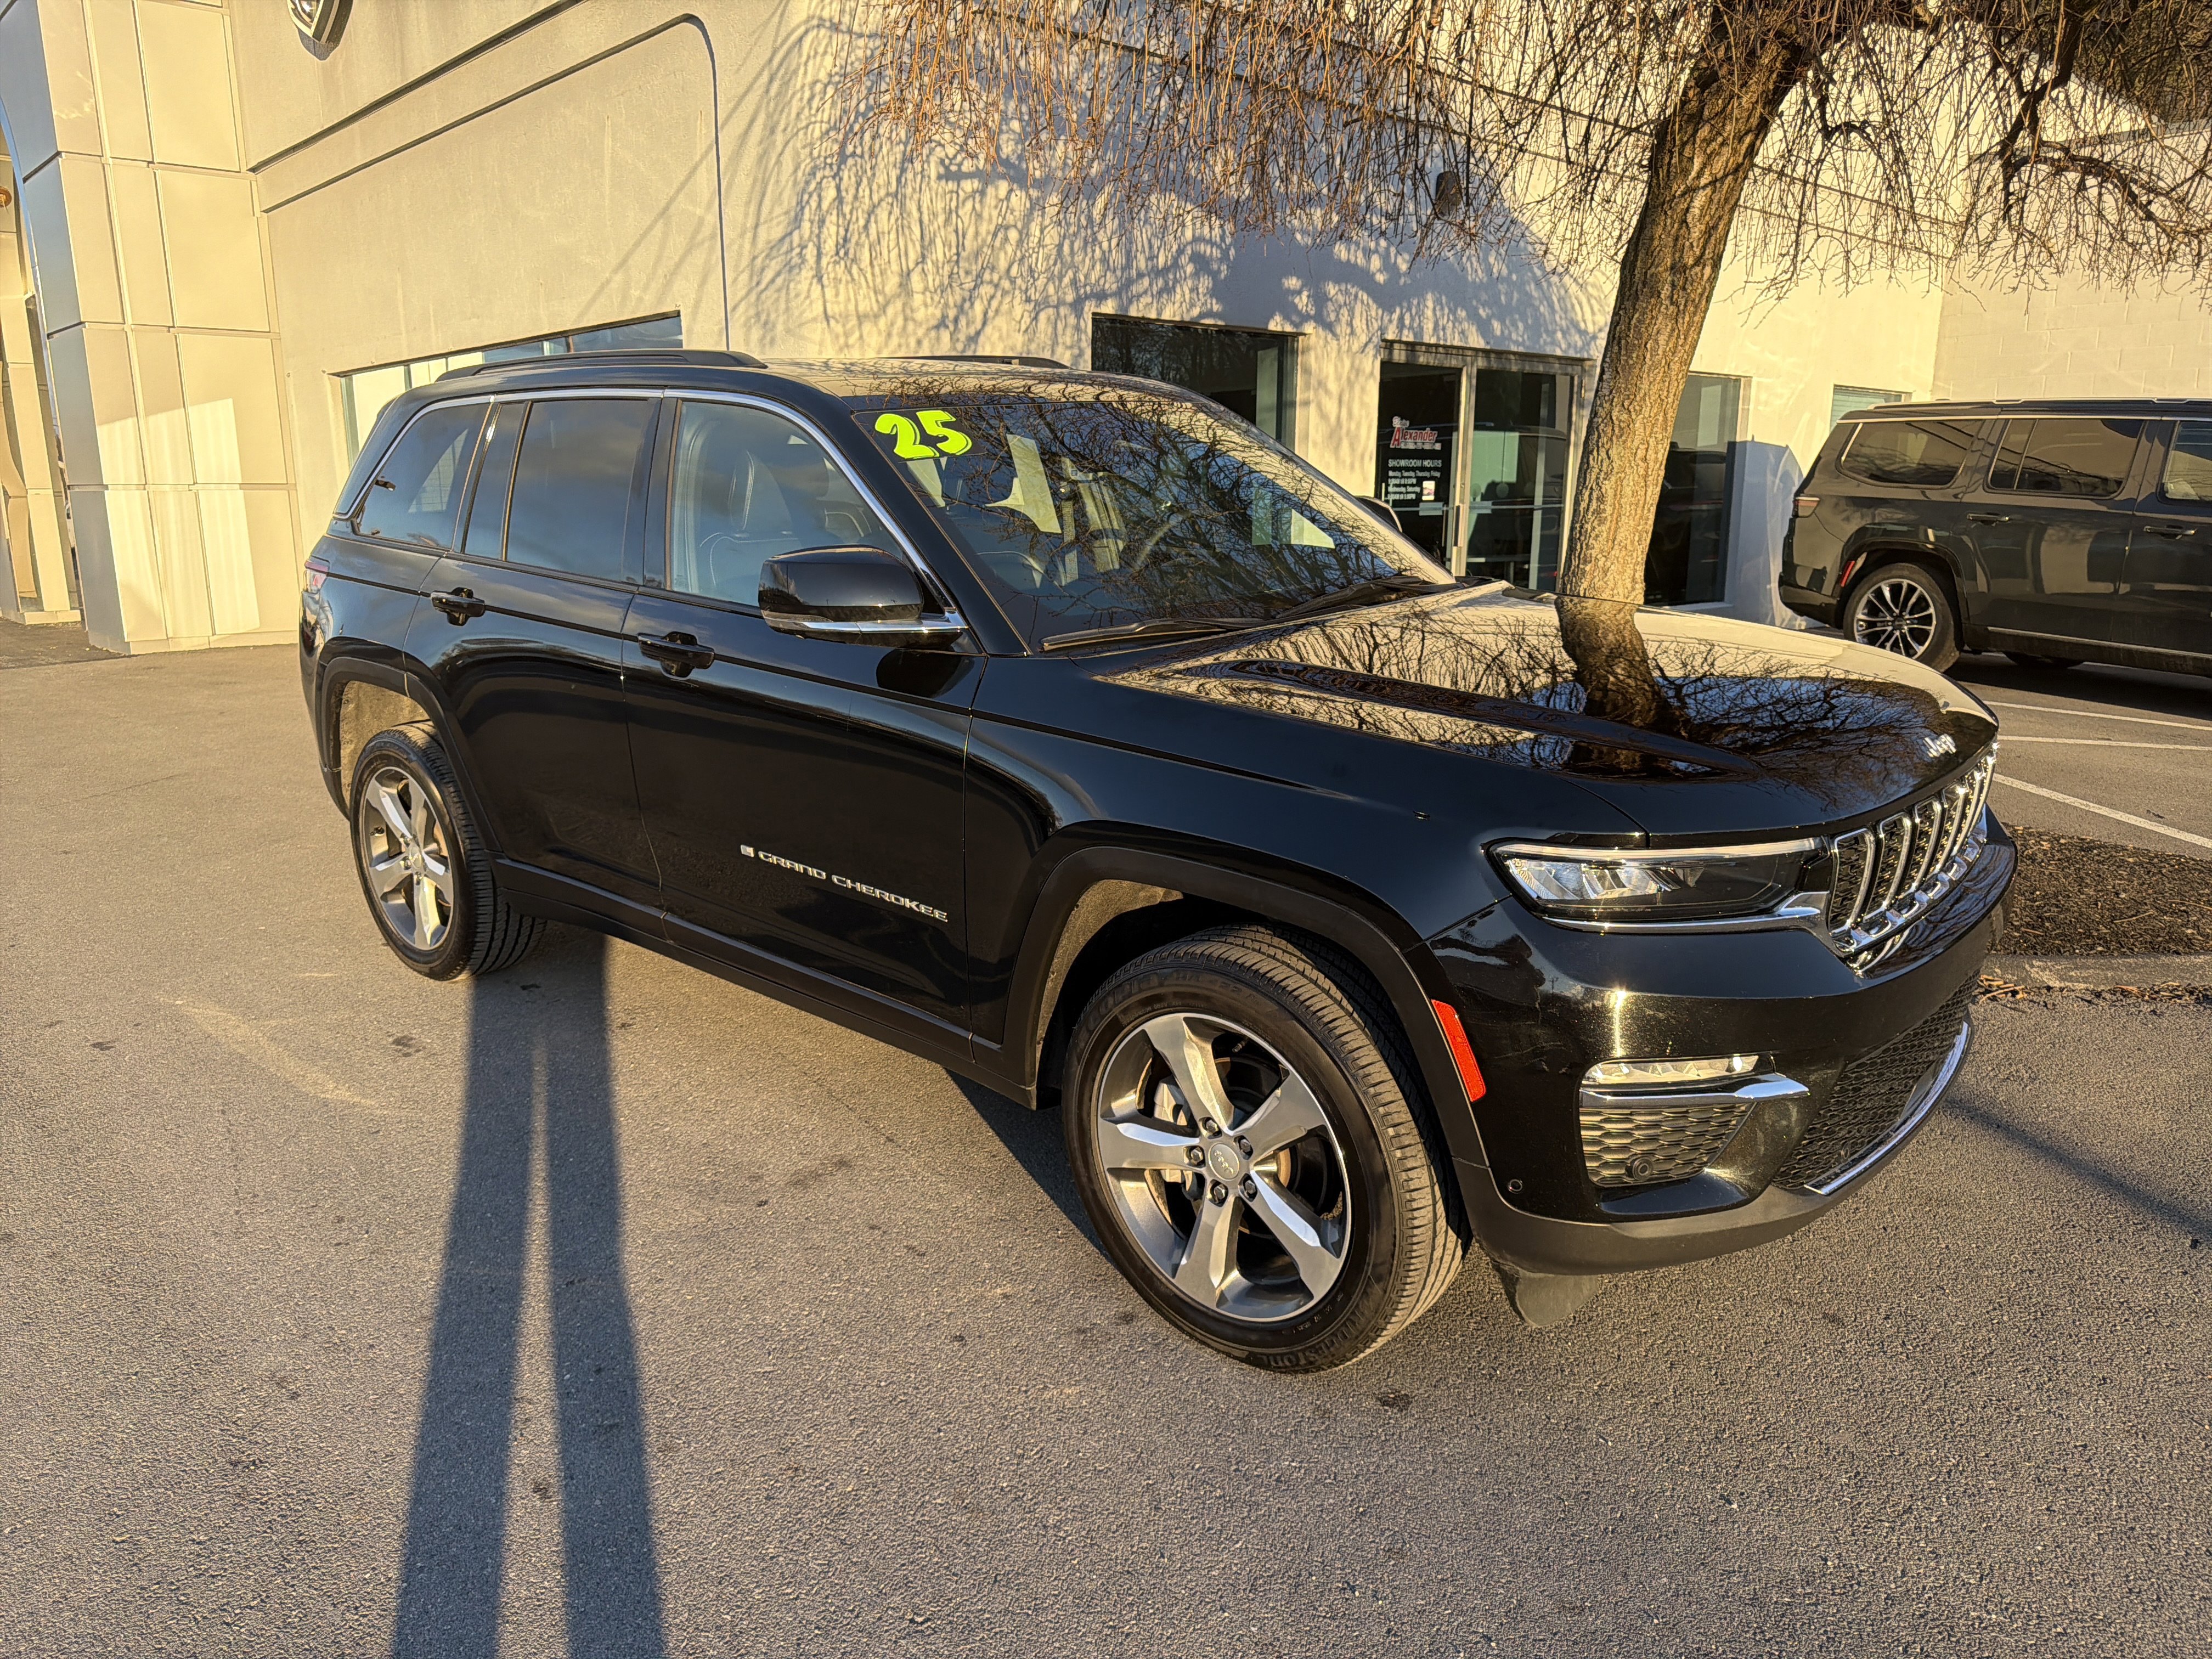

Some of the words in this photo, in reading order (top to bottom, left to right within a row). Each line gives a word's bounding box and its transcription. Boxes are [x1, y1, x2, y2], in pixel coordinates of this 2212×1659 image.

[874, 410, 972, 459] 25
[1390, 427, 1437, 448] Alexander
[1388, 459, 1422, 467] SHOWROOM
[1423, 459, 1442, 467] HOURS
[1922, 733, 1957, 757] Jeep
[758, 851, 826, 879] GRAND
[831, 874, 948, 923] CHEROKEE
